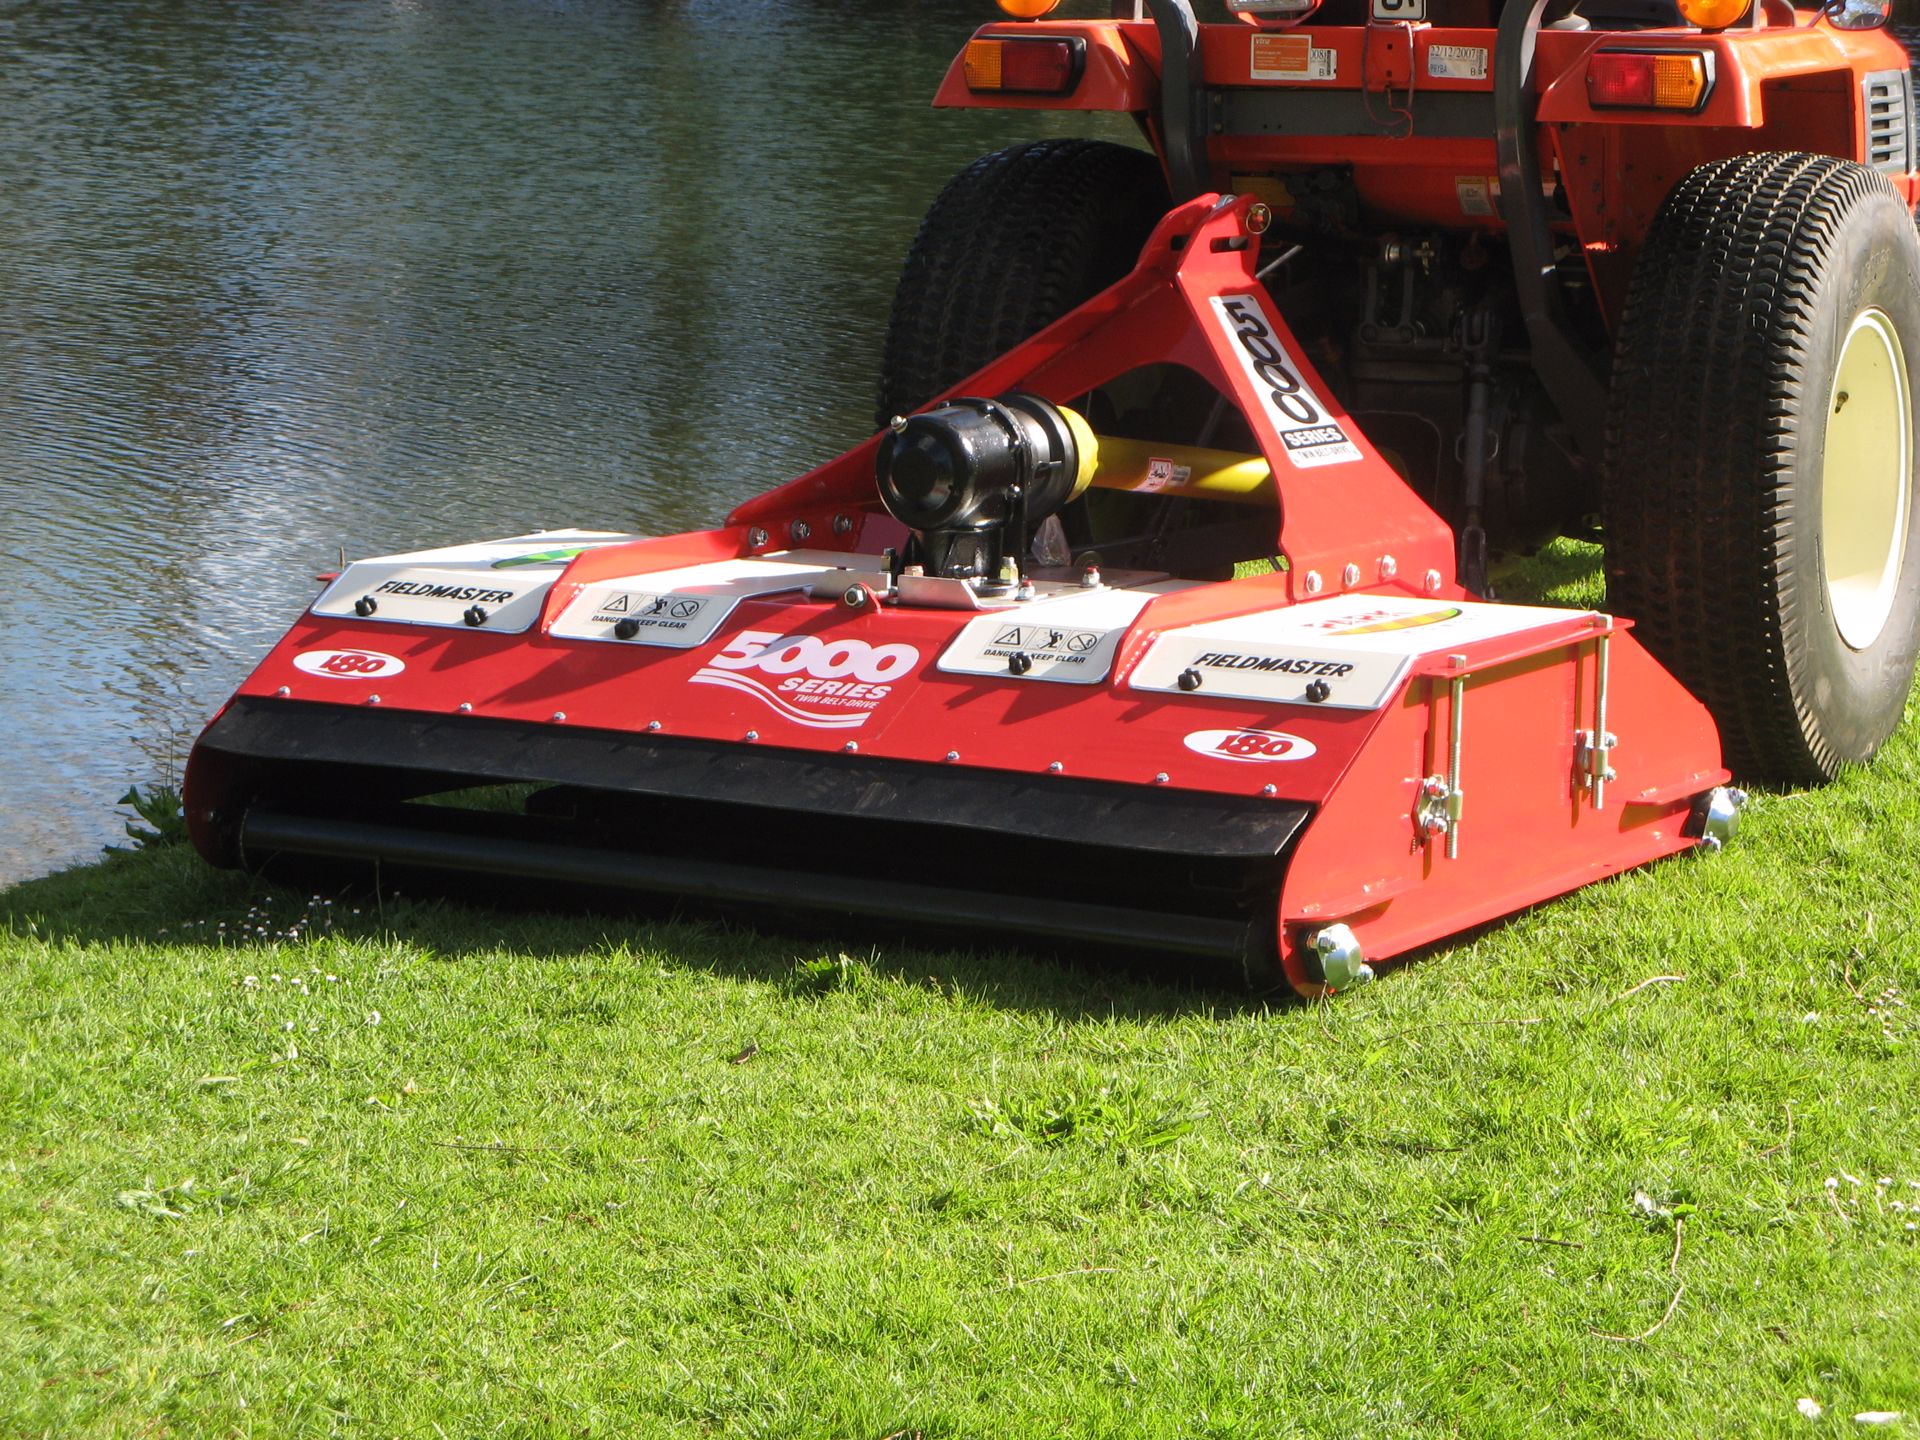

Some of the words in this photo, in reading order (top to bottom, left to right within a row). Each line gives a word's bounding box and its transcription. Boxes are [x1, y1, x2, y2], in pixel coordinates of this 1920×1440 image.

[1430, 45, 1476, 59] 22/12/2007
[1222, 301, 1319, 424] 5000
[1284, 427, 1343, 447] SERIES
[375, 580, 514, 603] FIELDMASTER
[658, 620, 688, 630] CLEAR
[318, 654, 387, 673] 180
[708, 630, 920, 683] 5000
[1055, 655, 1087, 664] CLEAR
[1194, 652, 1354, 678] FIELDMASTER
[777, 677, 892, 700] SERIES
[793, 694, 821, 705] TWIN
[819, 697, 881, 710] BELT-DRIVE
[1215, 734, 1294, 757] 180
